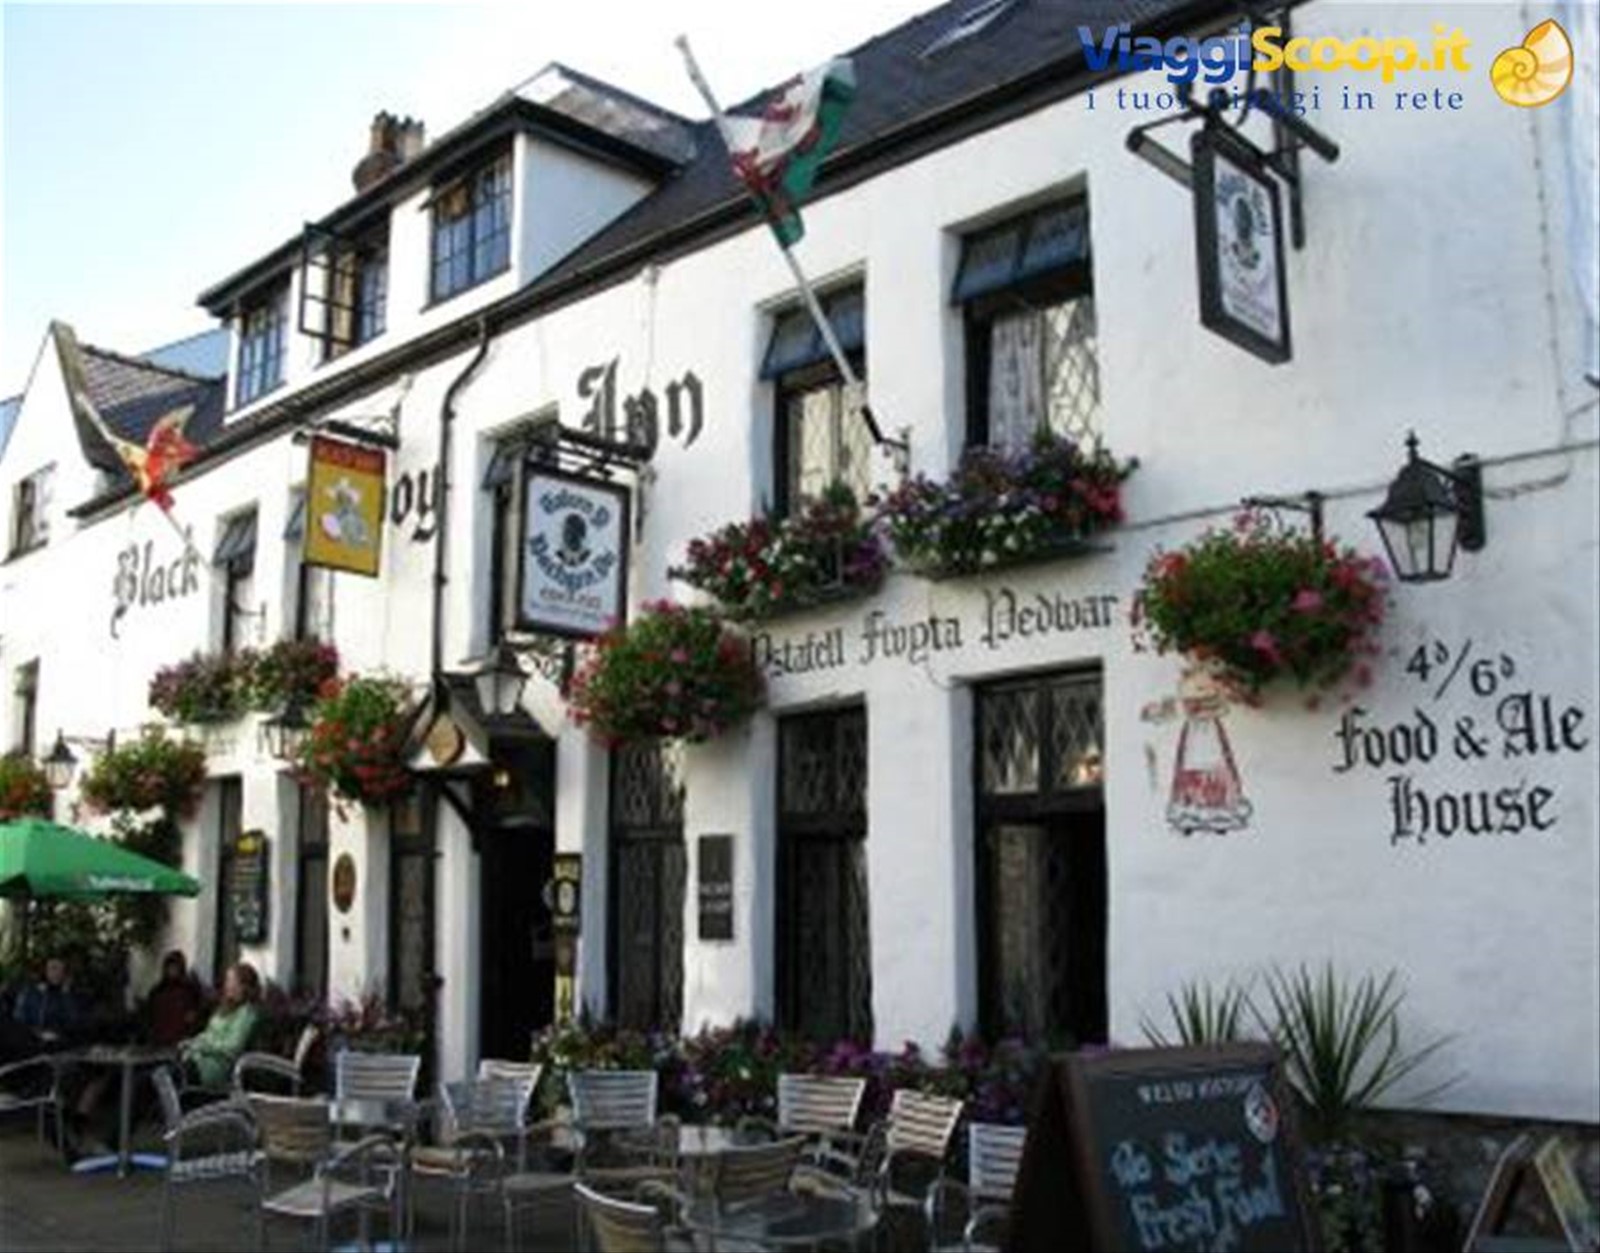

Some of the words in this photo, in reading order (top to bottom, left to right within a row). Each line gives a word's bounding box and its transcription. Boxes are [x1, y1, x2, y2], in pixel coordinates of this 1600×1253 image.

[390, 464, 440, 542] oy
[981, 586, 1119, 649] Pedwar
[1454, 716, 1490, 761] &
[1497, 690, 1590, 759] Ale
